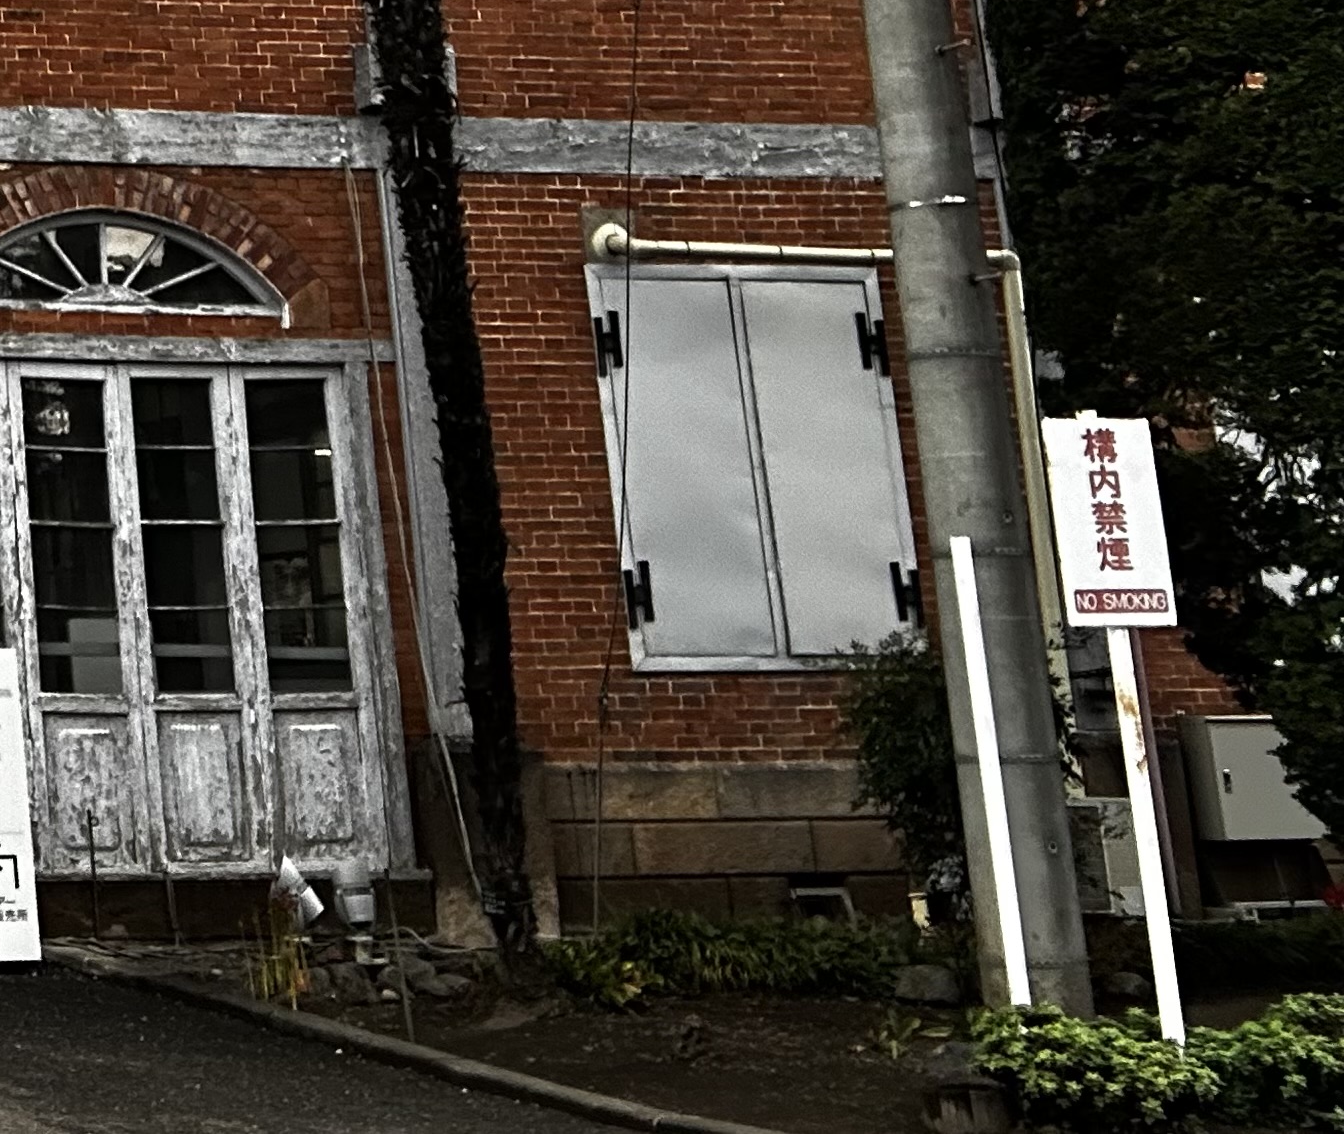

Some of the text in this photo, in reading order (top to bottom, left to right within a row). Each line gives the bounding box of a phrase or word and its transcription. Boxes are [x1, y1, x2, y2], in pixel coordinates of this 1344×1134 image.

[1081, 428, 1134, 571] 構内禁煙
[1076, 595, 1166, 610] NO SMOKING
